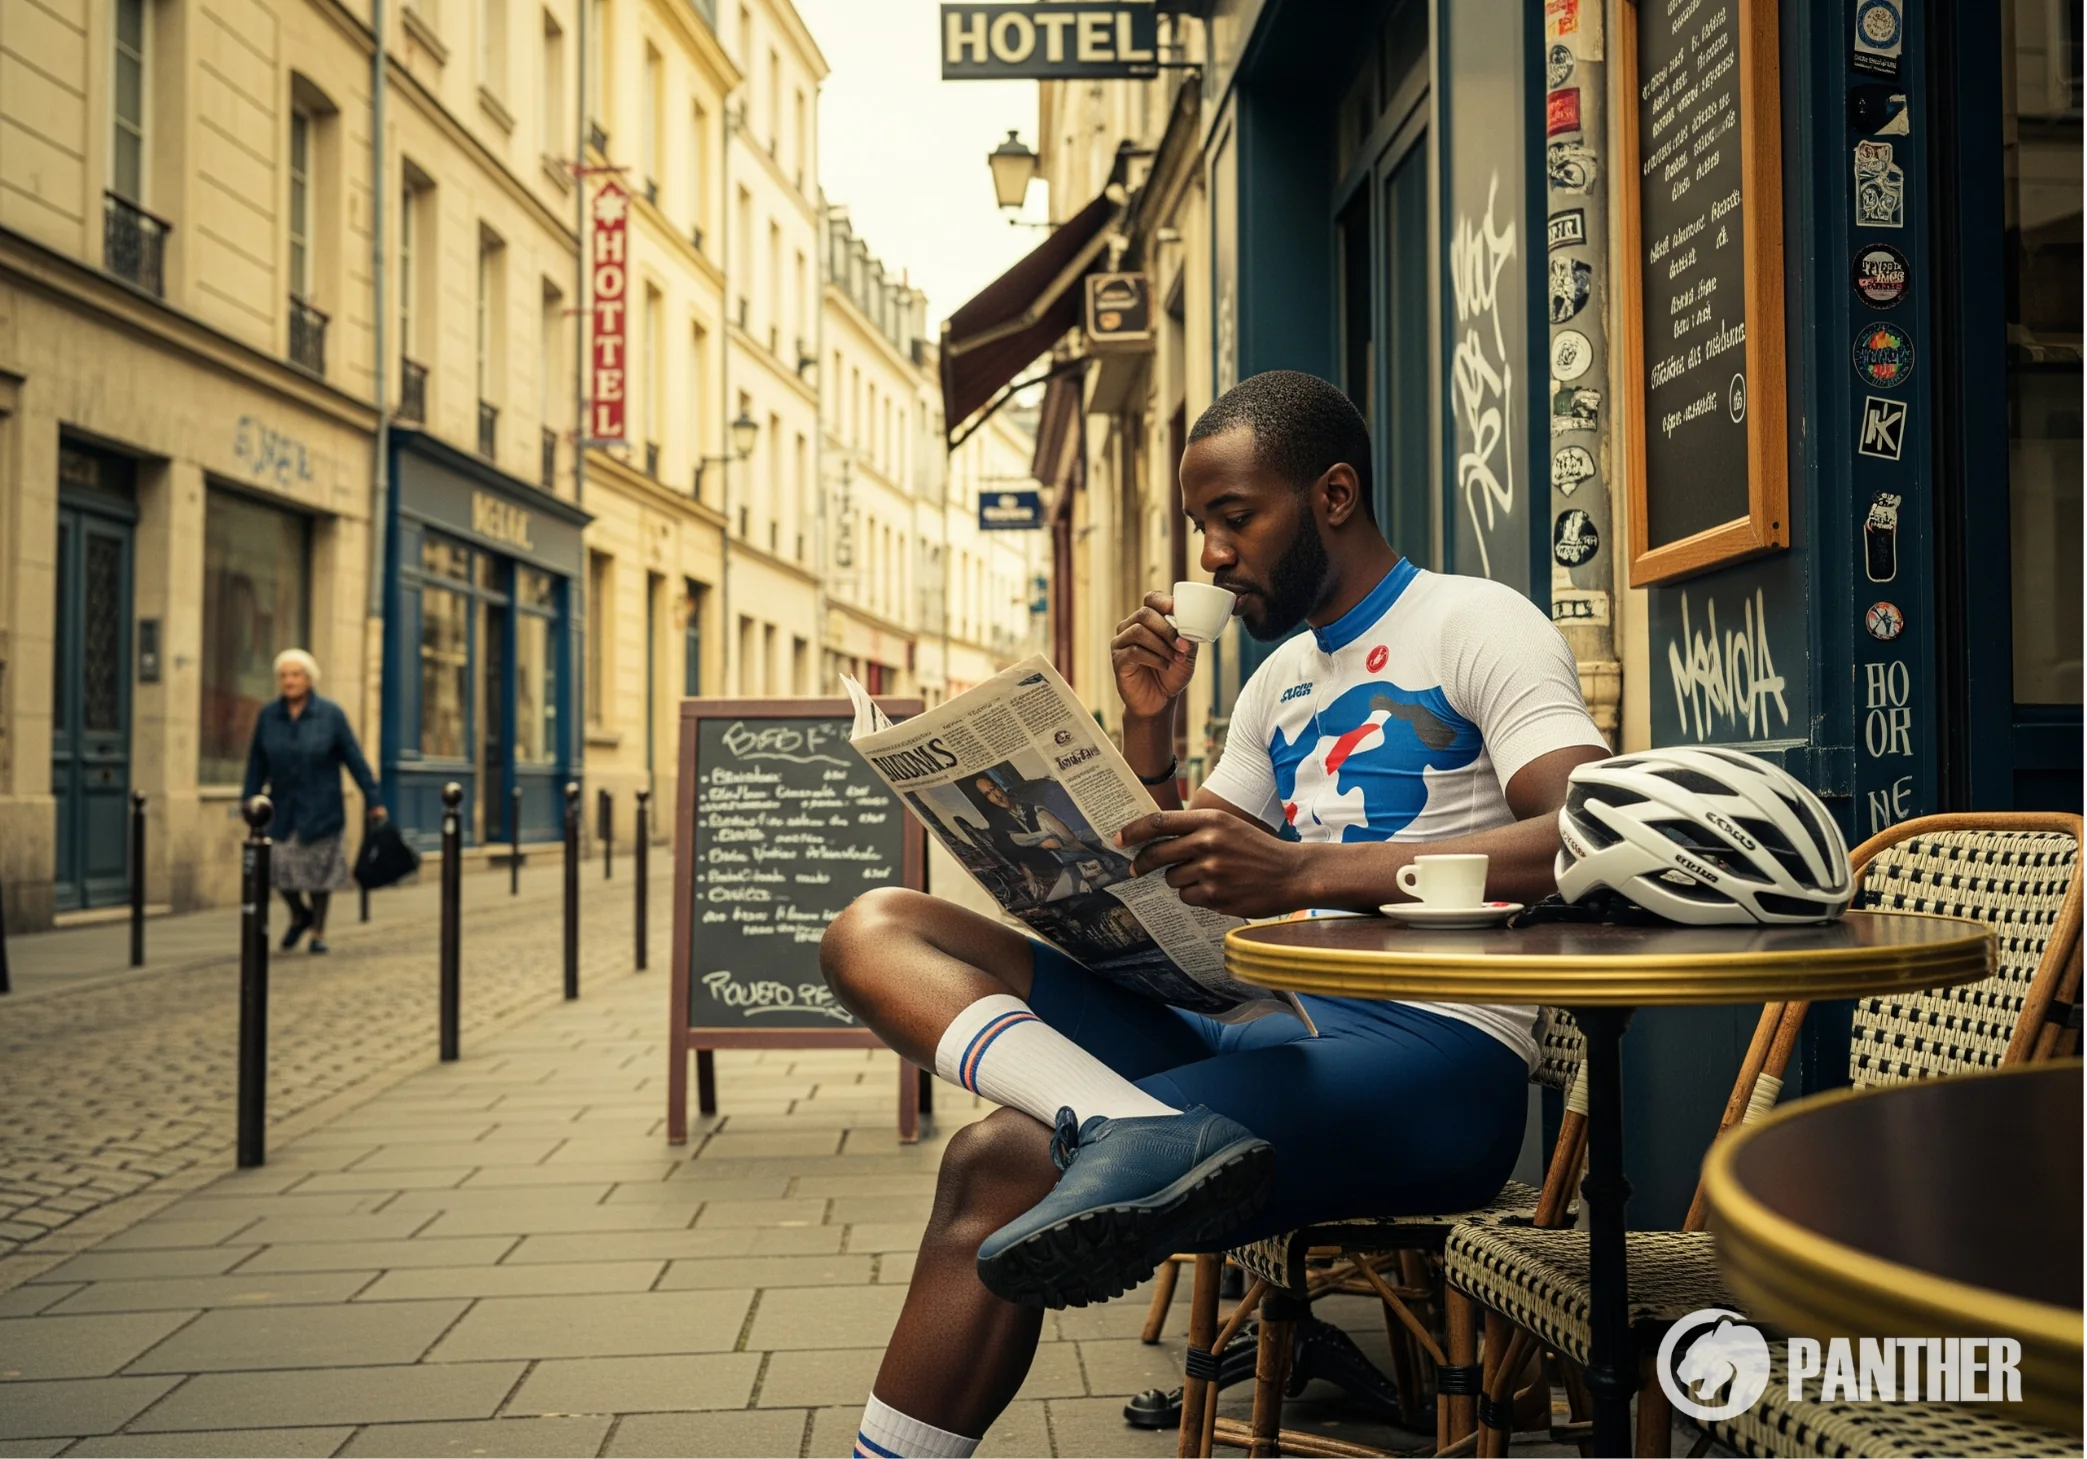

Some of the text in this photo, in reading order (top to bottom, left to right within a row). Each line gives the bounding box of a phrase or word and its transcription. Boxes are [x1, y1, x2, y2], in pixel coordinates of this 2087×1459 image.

[945, 11, 1154, 64] HOTEL
[1865, 660, 1910, 709] HO
[1865, 707, 1914, 758] OR
[1867, 775, 1913, 836] NE
